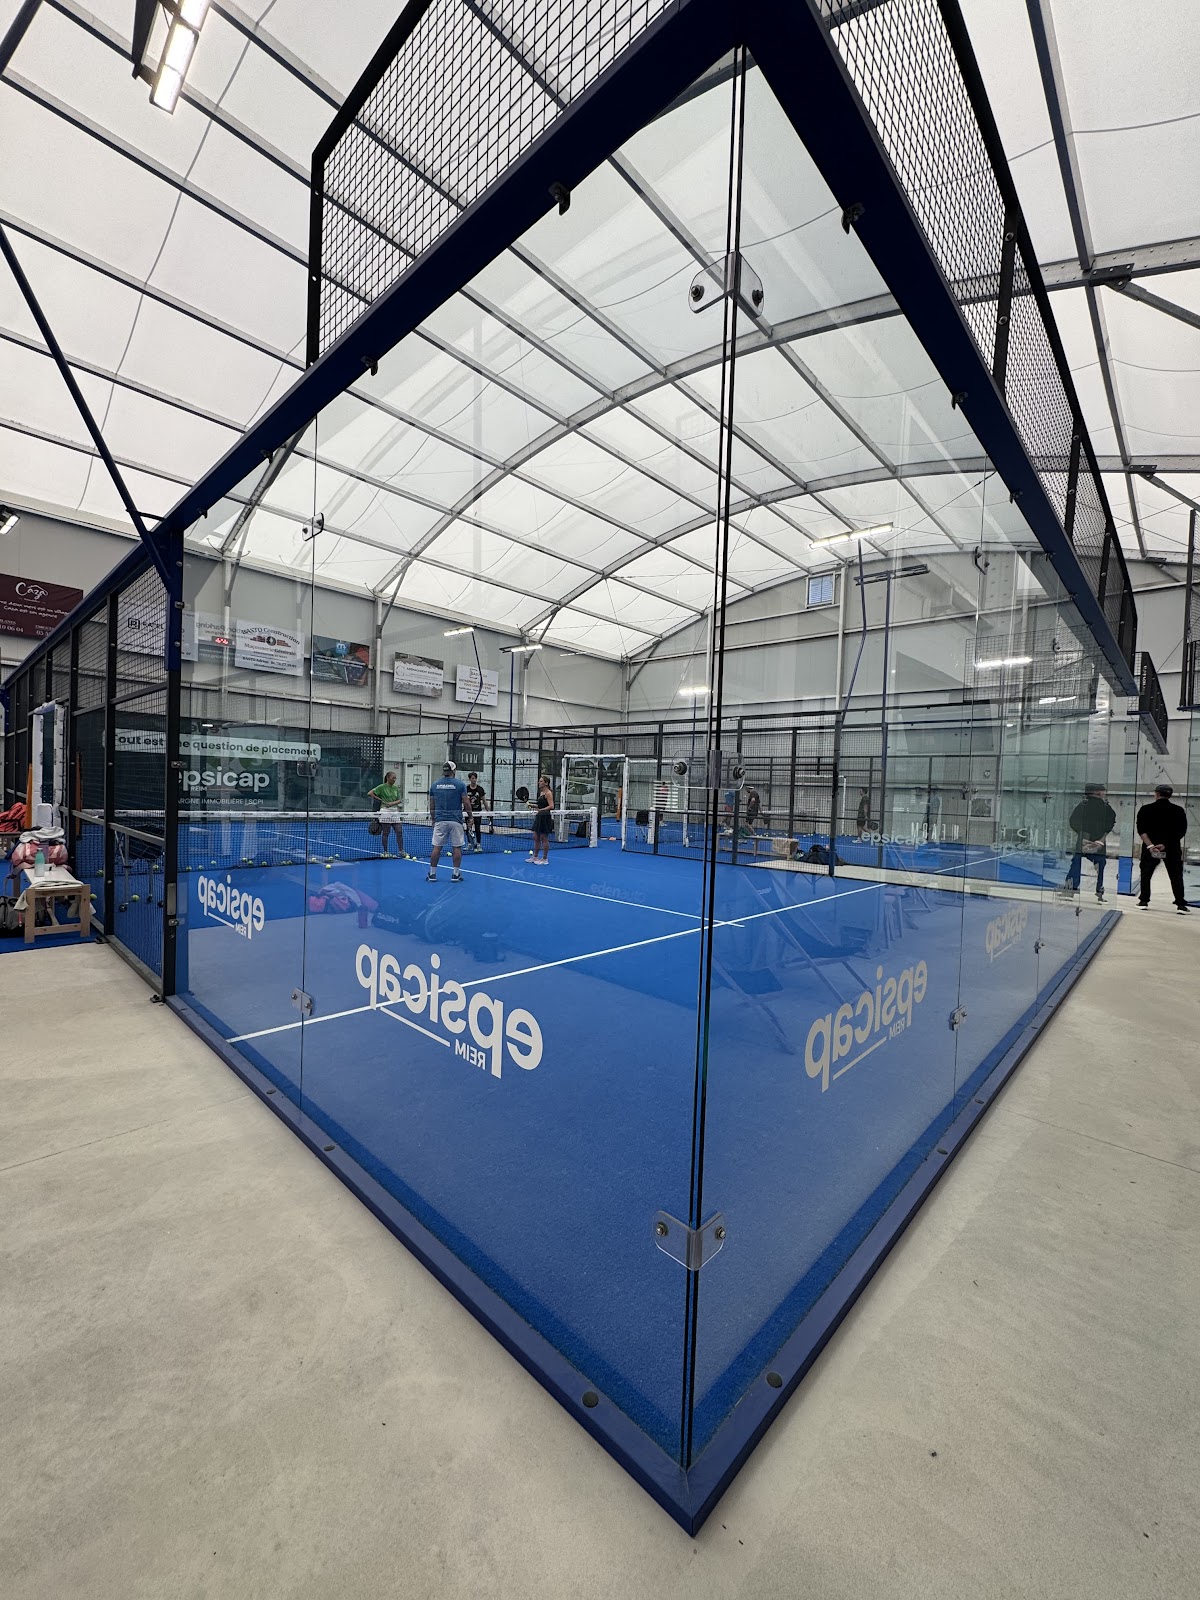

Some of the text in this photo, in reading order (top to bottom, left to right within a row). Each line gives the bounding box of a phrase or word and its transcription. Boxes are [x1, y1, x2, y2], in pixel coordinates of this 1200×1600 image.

[263, 627, 301, 645] Construction
[115, 734, 142, 745] out
[144, 737, 164, 746] est
[193, 741, 243, 752] question
[246, 743, 259, 752] de
[262, 744, 316, 756] placement
[178, 766, 270, 793] psicap
[861, 830, 928, 850] epsicap
